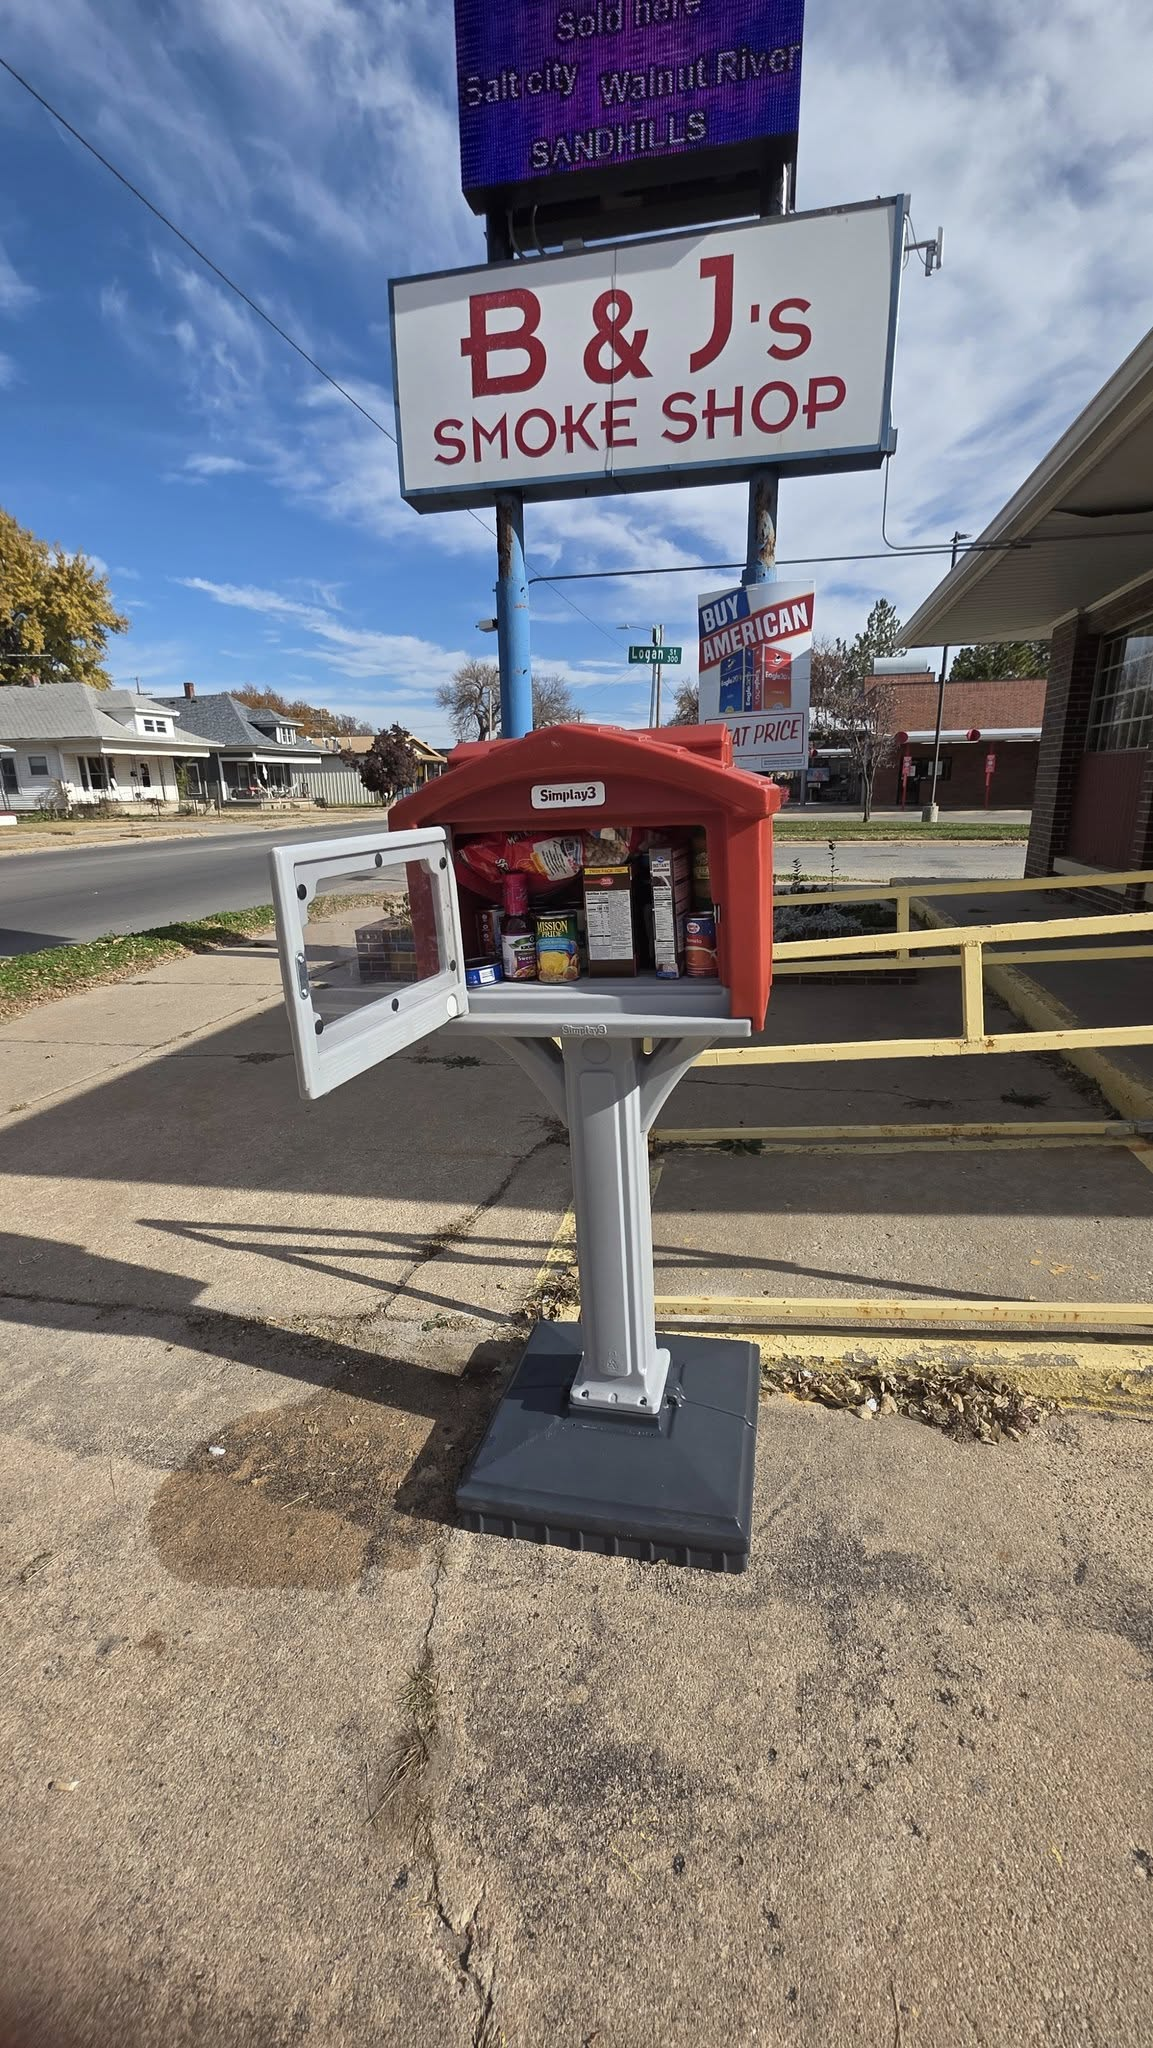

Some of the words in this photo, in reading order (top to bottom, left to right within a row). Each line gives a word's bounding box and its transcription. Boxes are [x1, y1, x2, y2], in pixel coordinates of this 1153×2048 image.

[556, 0, 623, 40] Sold
[635, 0, 701, 26] here
[462, 71, 520, 107] Salt
[526, 60, 578, 97] city
[599, 57, 708, 106] Walnut
[715, 44, 801, 85] River
[531, 111, 707, 169] SANDHILLS
[460, 287, 547, 399] B
[583, 288, 654, 384] &
[433, 397, 638, 466] SMOKE
[661, 375, 847, 444] SHOP
[702, 593, 739, 633] BUY
[702, 601, 809, 664] AMERICAN
[631, 648, 664, 661] Logan
[669, 648, 677, 656] St
[667, 655, 679, 664] 300
[753, 719, 801, 745] PRICE
[540, 786, 597, 803] Simplay3
[536, 920, 568, 935] MISSION
[541, 930, 562, 938] PRIDE
[561, 1023, 608, 1037] Simplay3
